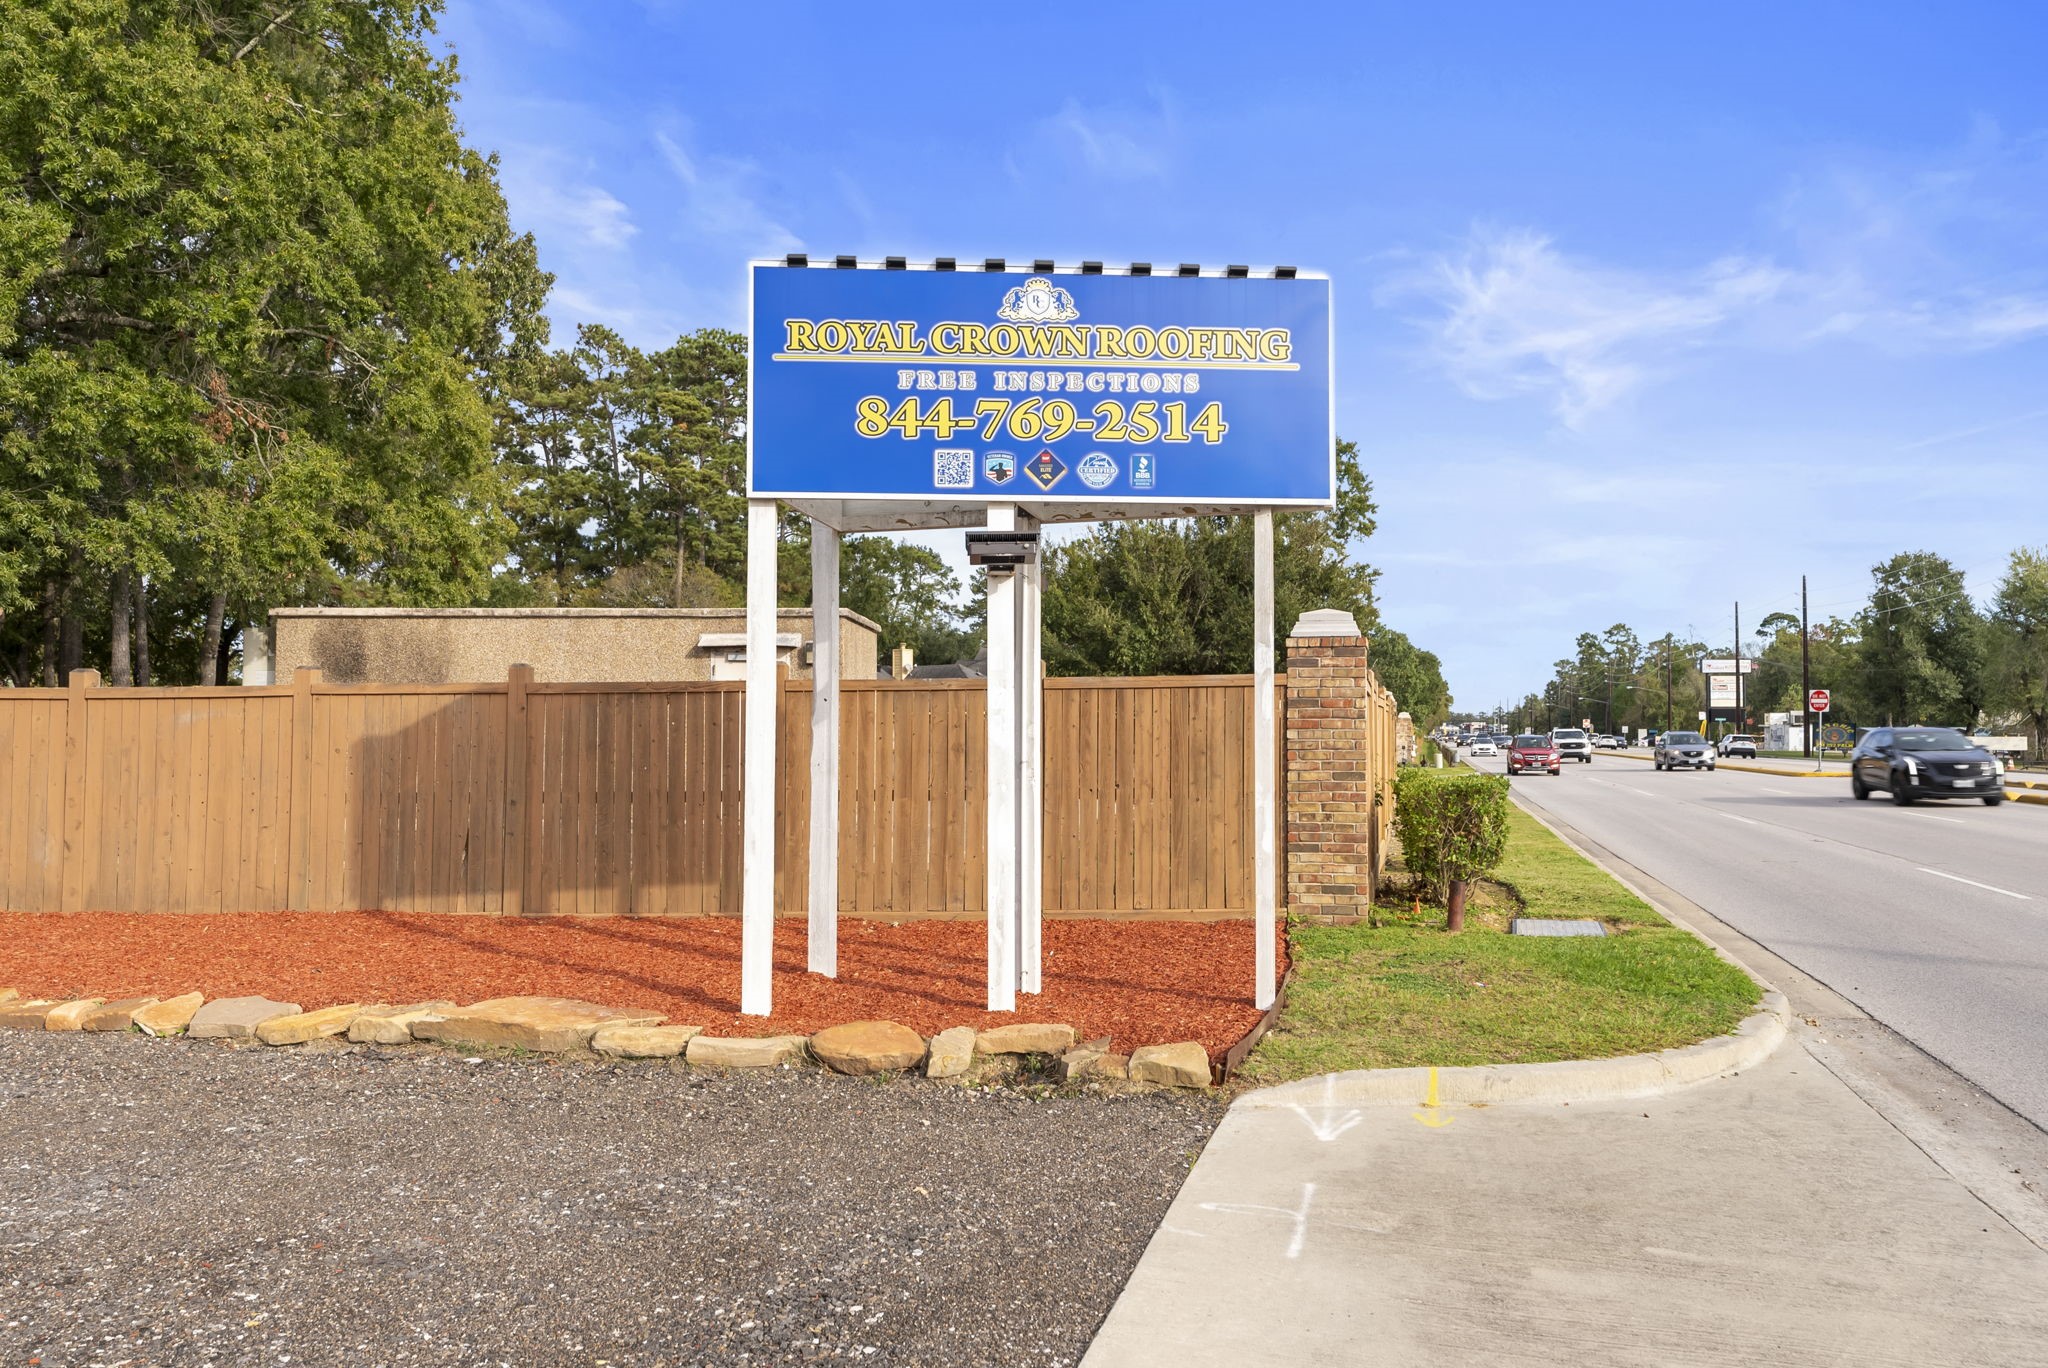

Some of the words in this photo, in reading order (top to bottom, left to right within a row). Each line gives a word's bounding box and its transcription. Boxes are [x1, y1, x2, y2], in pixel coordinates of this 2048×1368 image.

[786, 320, 925, 354] ROYAL
[930, 323, 1091, 356] CROWN
[1096, 327, 1290, 361] ROOFING
[898, 370, 976, 390] FREE
[994, 371, 1200, 393] INSPECTIONS
[856, 397, 1227, 443] 844-769-2514
